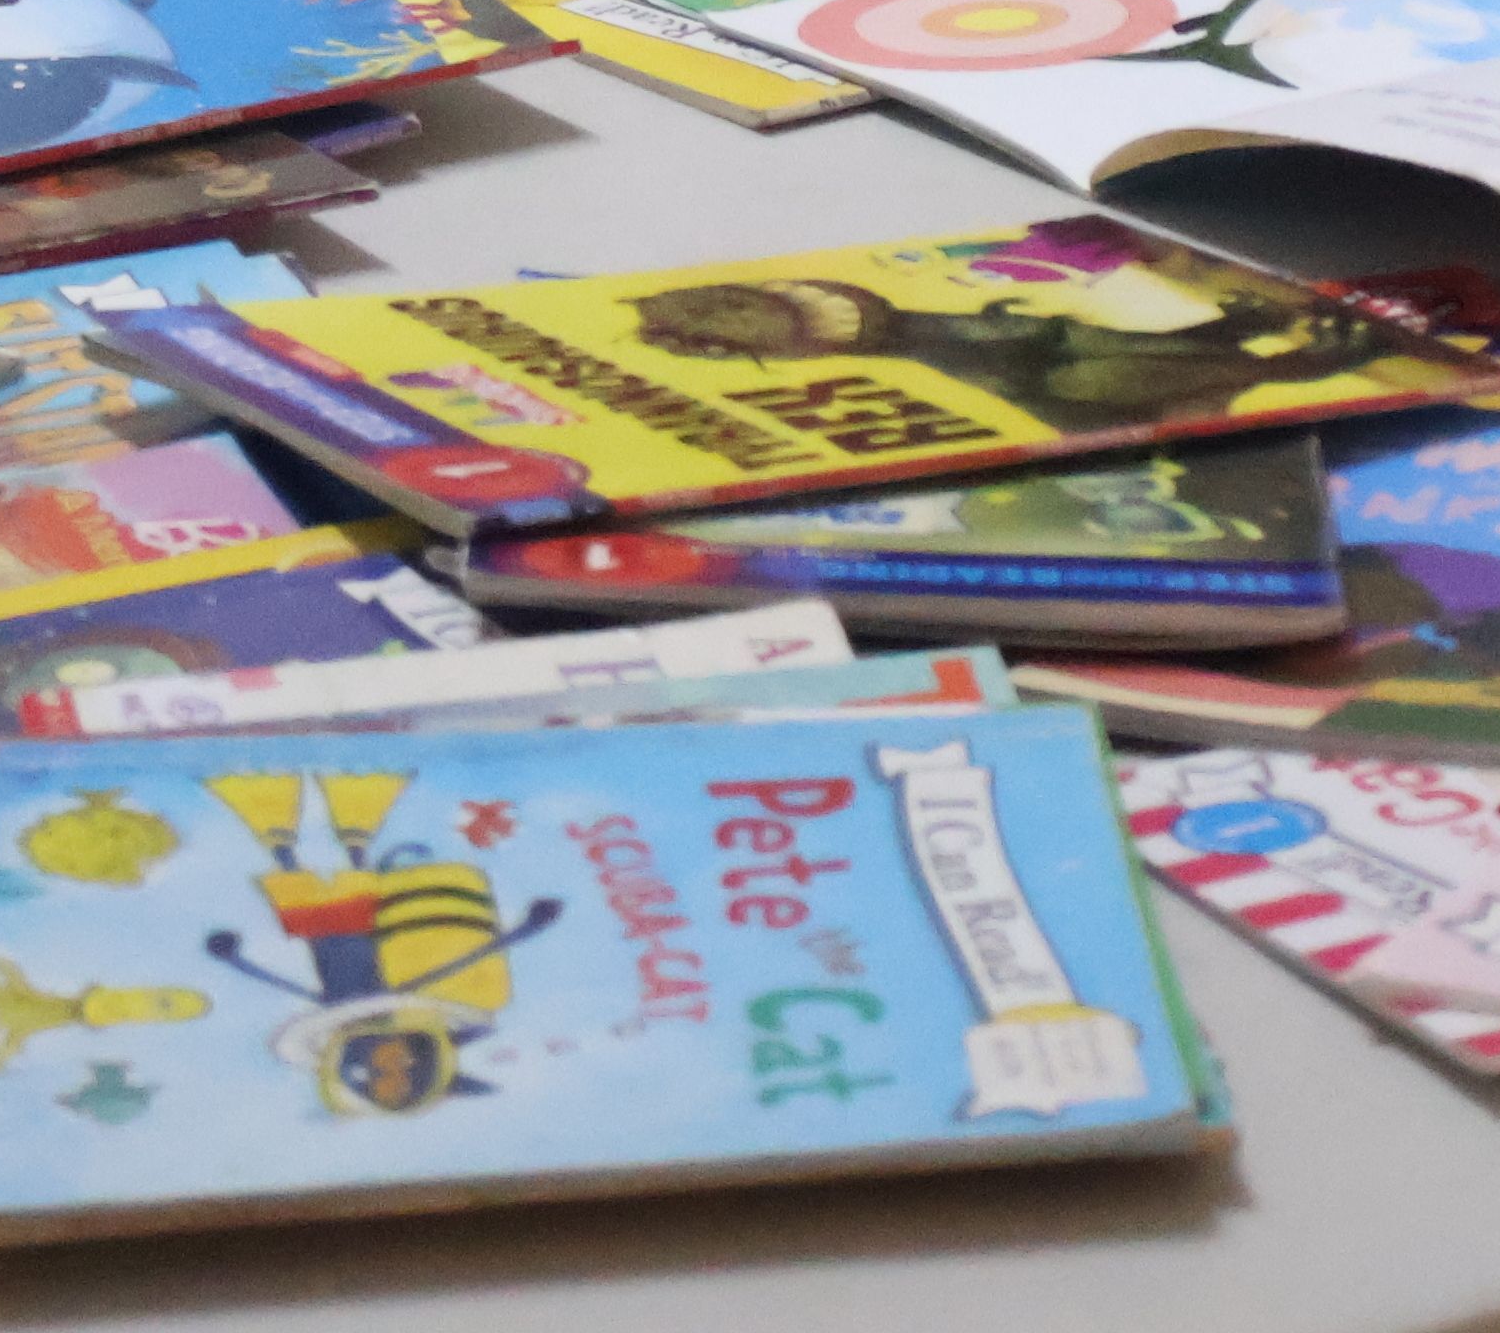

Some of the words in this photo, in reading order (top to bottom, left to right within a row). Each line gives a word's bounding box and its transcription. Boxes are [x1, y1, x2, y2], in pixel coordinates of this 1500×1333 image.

[587, 0, 707, 38] Read!
[703, 773, 859, 931] Pete
[921, 819, 989, 892] Can
[564, 813, 711, 1024] SCUBA-CAT
[745, 984, 899, 1108] Cat
